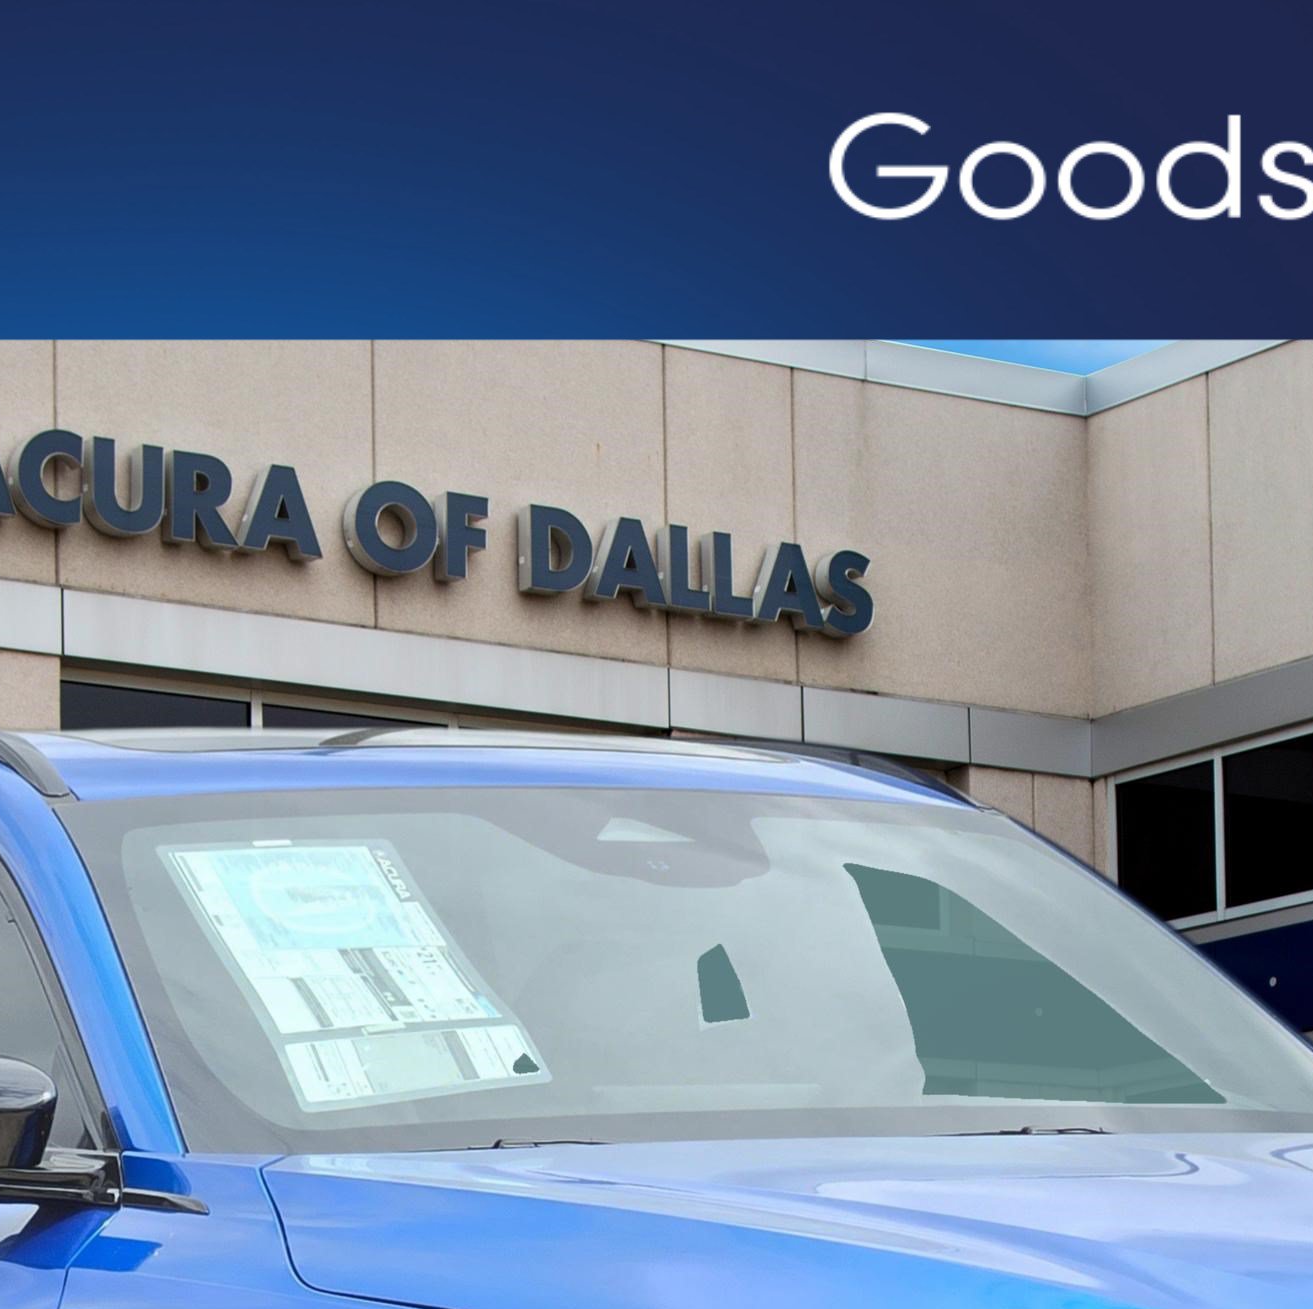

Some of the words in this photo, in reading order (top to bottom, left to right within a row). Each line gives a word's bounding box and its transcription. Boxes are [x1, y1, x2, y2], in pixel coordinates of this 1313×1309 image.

[343, 479, 488, 582] OF
[518, 503, 876, 638] DALLAS
[378, 857, 412, 900] ACURA
